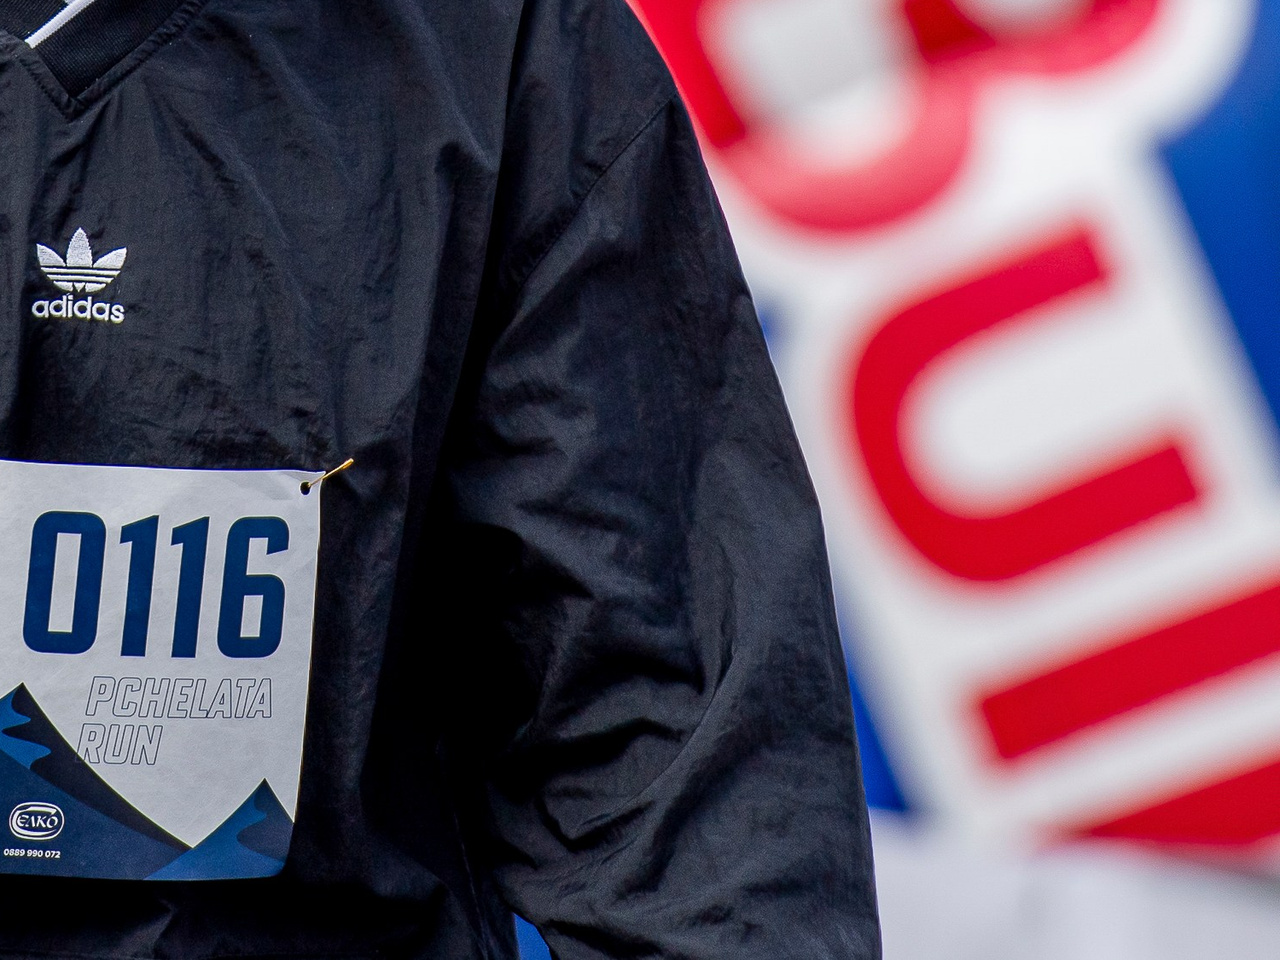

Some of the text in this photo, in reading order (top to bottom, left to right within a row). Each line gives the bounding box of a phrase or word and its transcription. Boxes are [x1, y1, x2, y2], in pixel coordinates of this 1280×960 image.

[31, 294, 125, 324] adidas
[22, 510, 290, 658] 0116
[84, 675, 272, 719] PCHELATA
[75, 722, 164, 766] RUN
[26, 849, 43, 858] 990
[44, 850, 61, 859] 072
